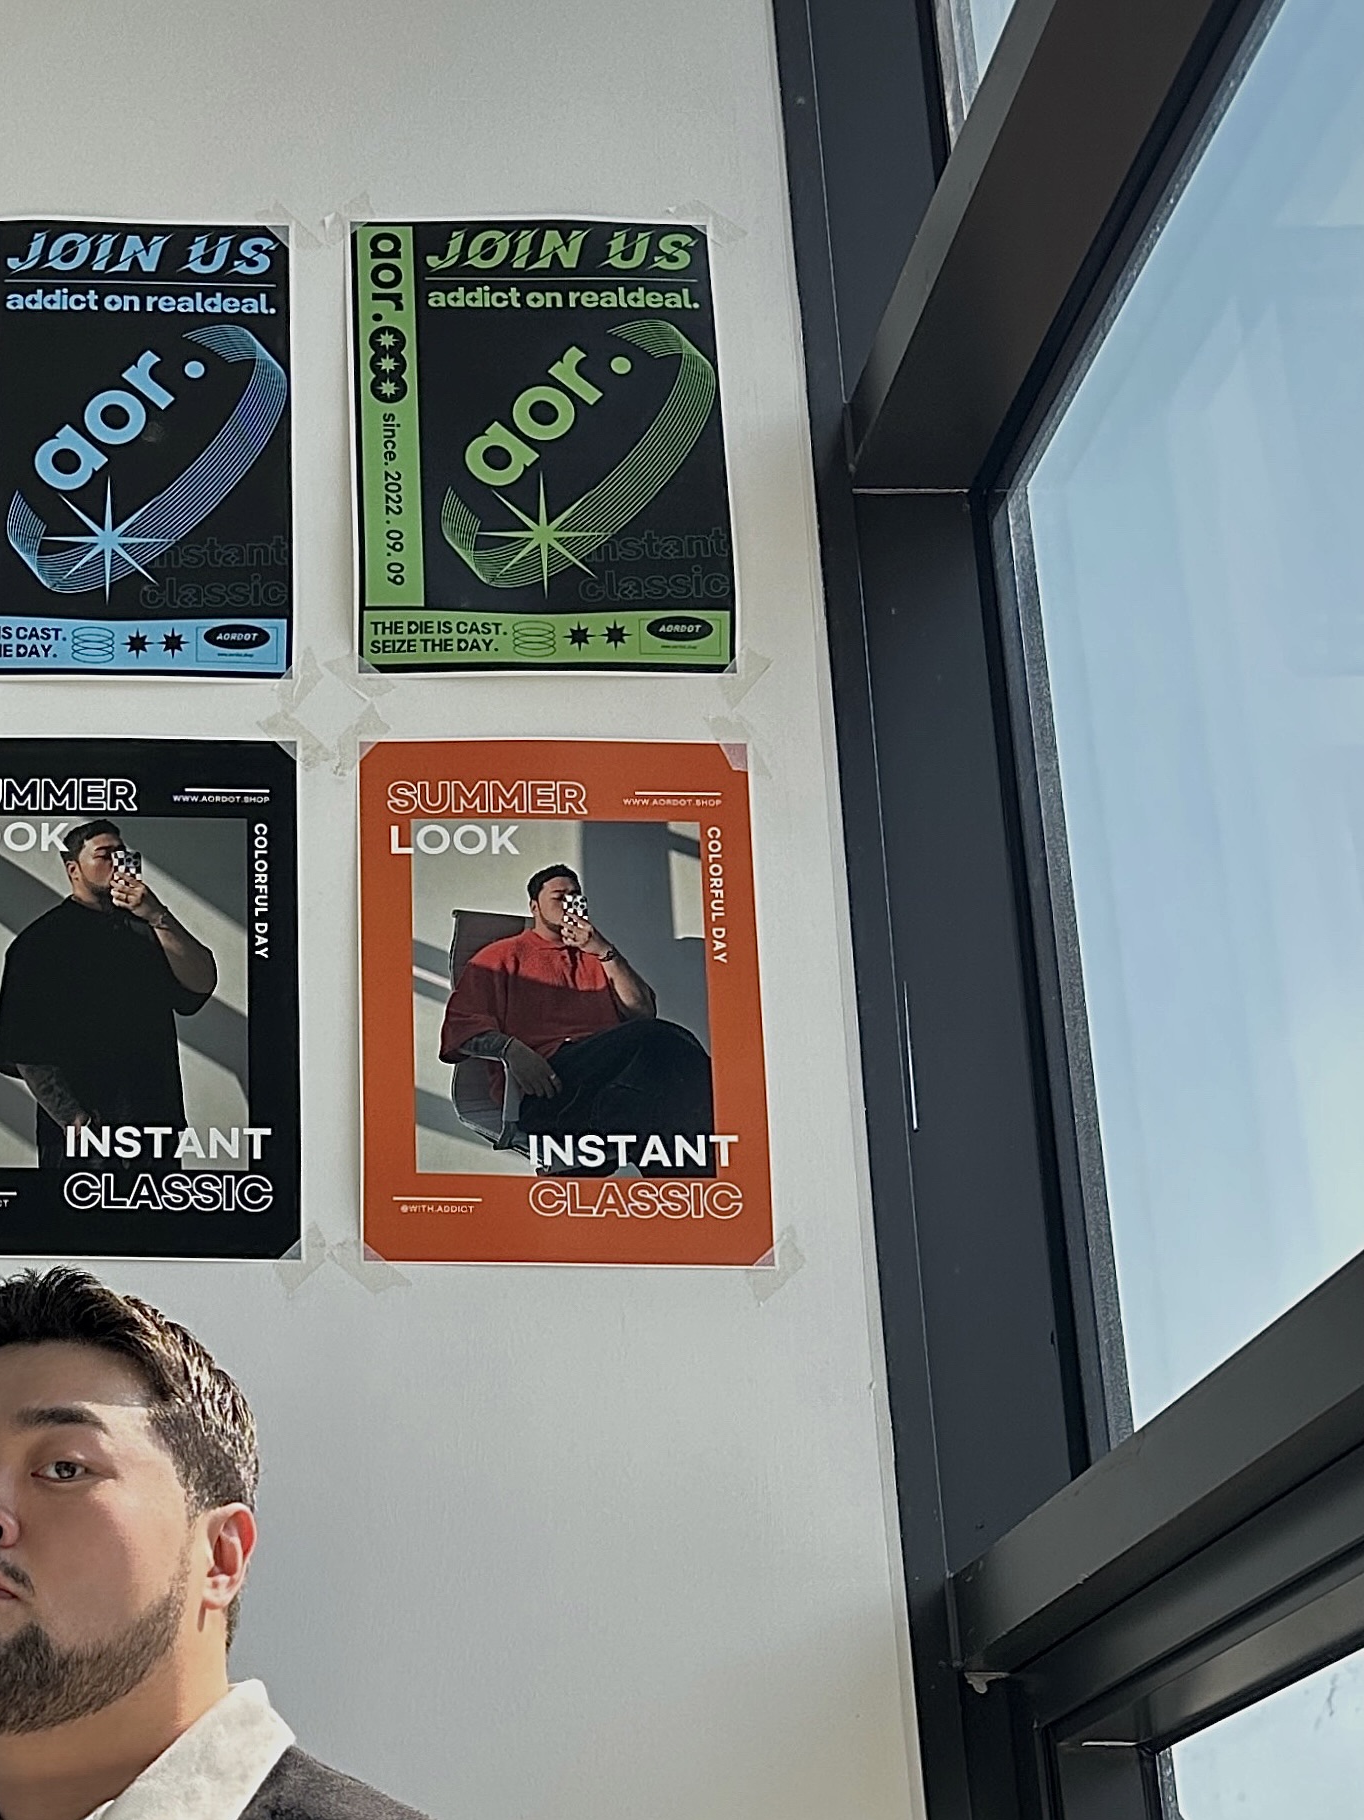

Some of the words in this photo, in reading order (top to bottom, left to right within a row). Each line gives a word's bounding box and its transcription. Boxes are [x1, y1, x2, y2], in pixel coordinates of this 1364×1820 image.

[7, 230, 175, 274] JOIN
[176, 232, 279, 275] US
[426, 228, 593, 272] JOIN
[596, 227, 699, 271] US
[6, 288, 98, 311] addict
[104, 295, 140, 311] on
[146, 292, 276, 314] realdeal.
[427, 285, 521, 307] addict
[526, 292, 562, 307] on
[569, 287, 700, 309] realdeal.
[35, 350, 205, 490] aor.
[465, 346, 632, 486] aor.
[383, 413, 401, 465] since.
[147, 535, 288, 568] nstant
[585, 527, 728, 562] nstant
[140, 573, 286, 608] classic
[579, 565, 730, 600] classic
[16, 627, 67, 641] CAST.
[216, 633, 258, 641] AORDOT
[370, 621, 403, 635] THE
[408, 621, 434, 634] DIE
[438, 621, 452, 634] IS
[457, 622, 508, 635] CAST.
[16, 644, 57, 658] DAY.
[370, 639, 416, 654] SEIZE
[420, 639, 453, 652] THE
[458, 639, 498, 652] DAY.
[387, 780, 588, 814] SUMMER
[390, 824, 519, 855] LOOK
[254, 823, 268, 916] COLORFUL
[707, 827, 725, 922] COLORFUL
[255, 922, 268, 958] DAY
[712, 927, 727, 963] DAY
[66, 1126, 271, 1159] INSTANT
[528, 1135, 739, 1168] INSTANT
[64, 1172, 273, 1212] CLASSIC
[529, 1180, 743, 1219] CLASSIC
